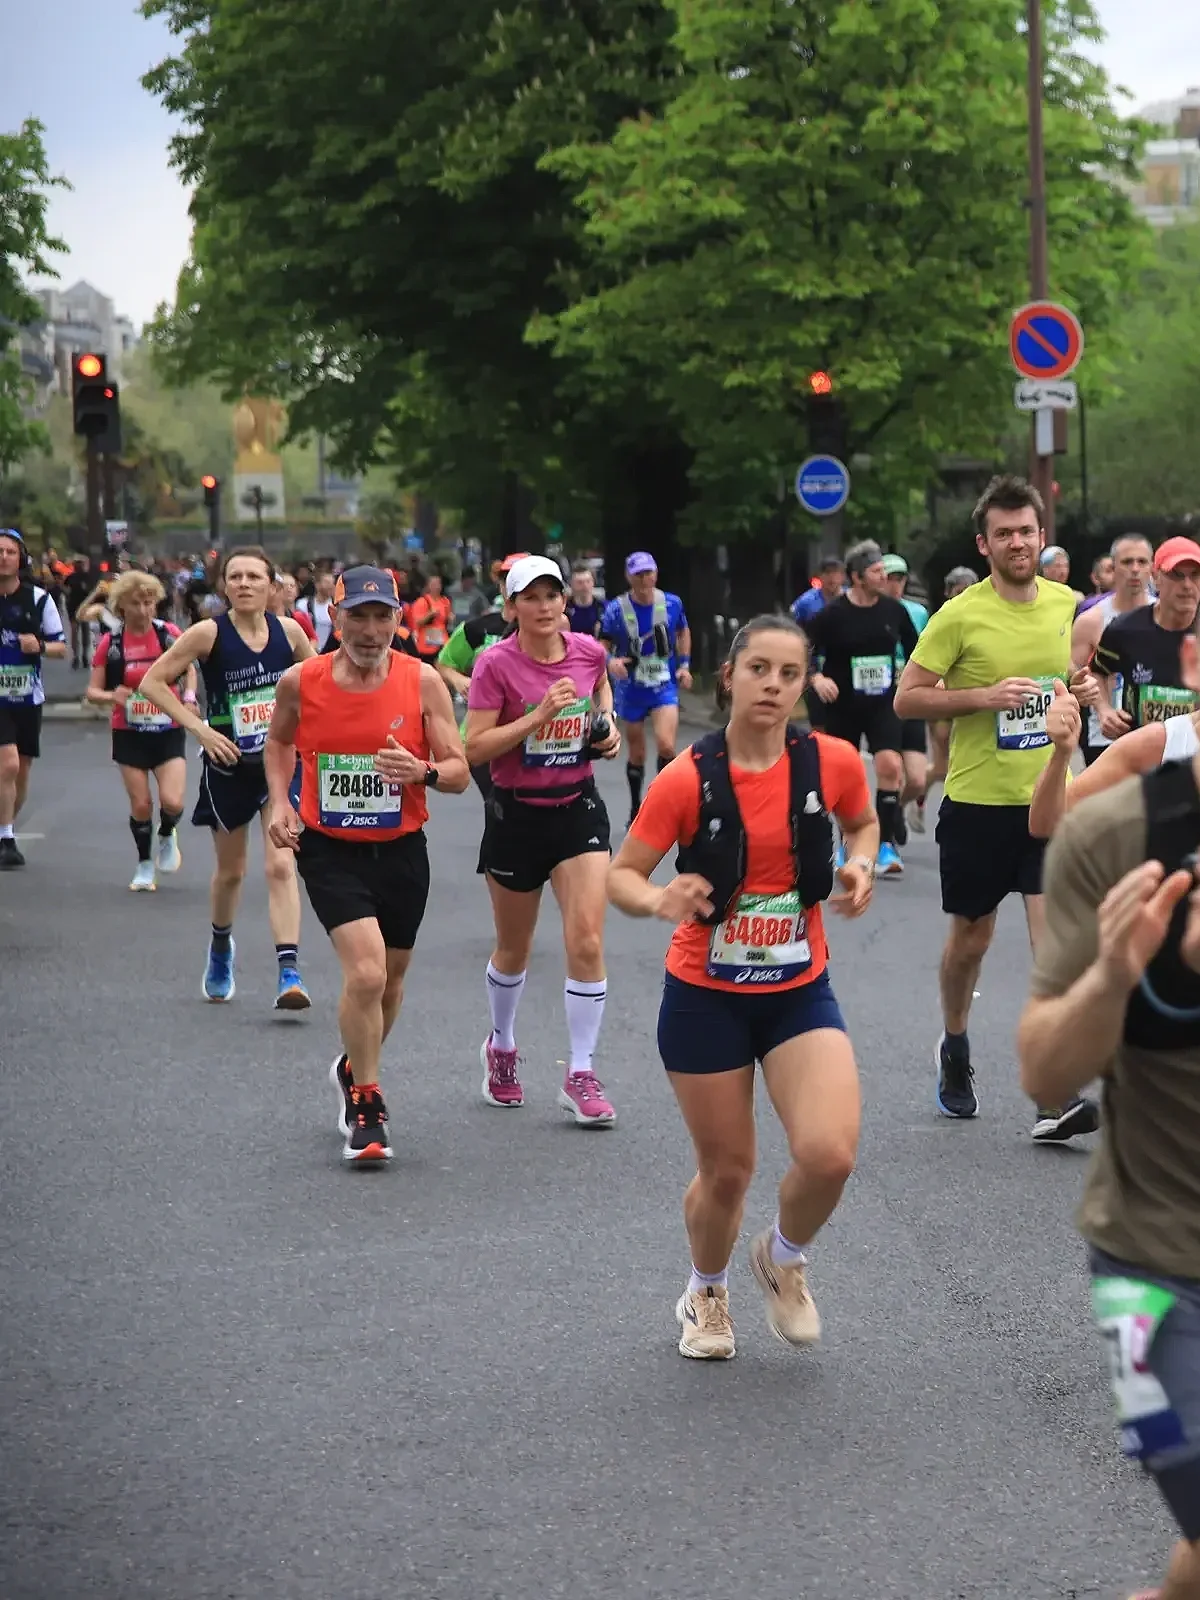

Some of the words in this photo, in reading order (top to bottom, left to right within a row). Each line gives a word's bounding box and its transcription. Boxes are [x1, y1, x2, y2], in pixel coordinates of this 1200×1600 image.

[536, 718, 581, 742] 37829
[329, 774, 384, 797] 28488
[725, 914, 793, 947] 54886
